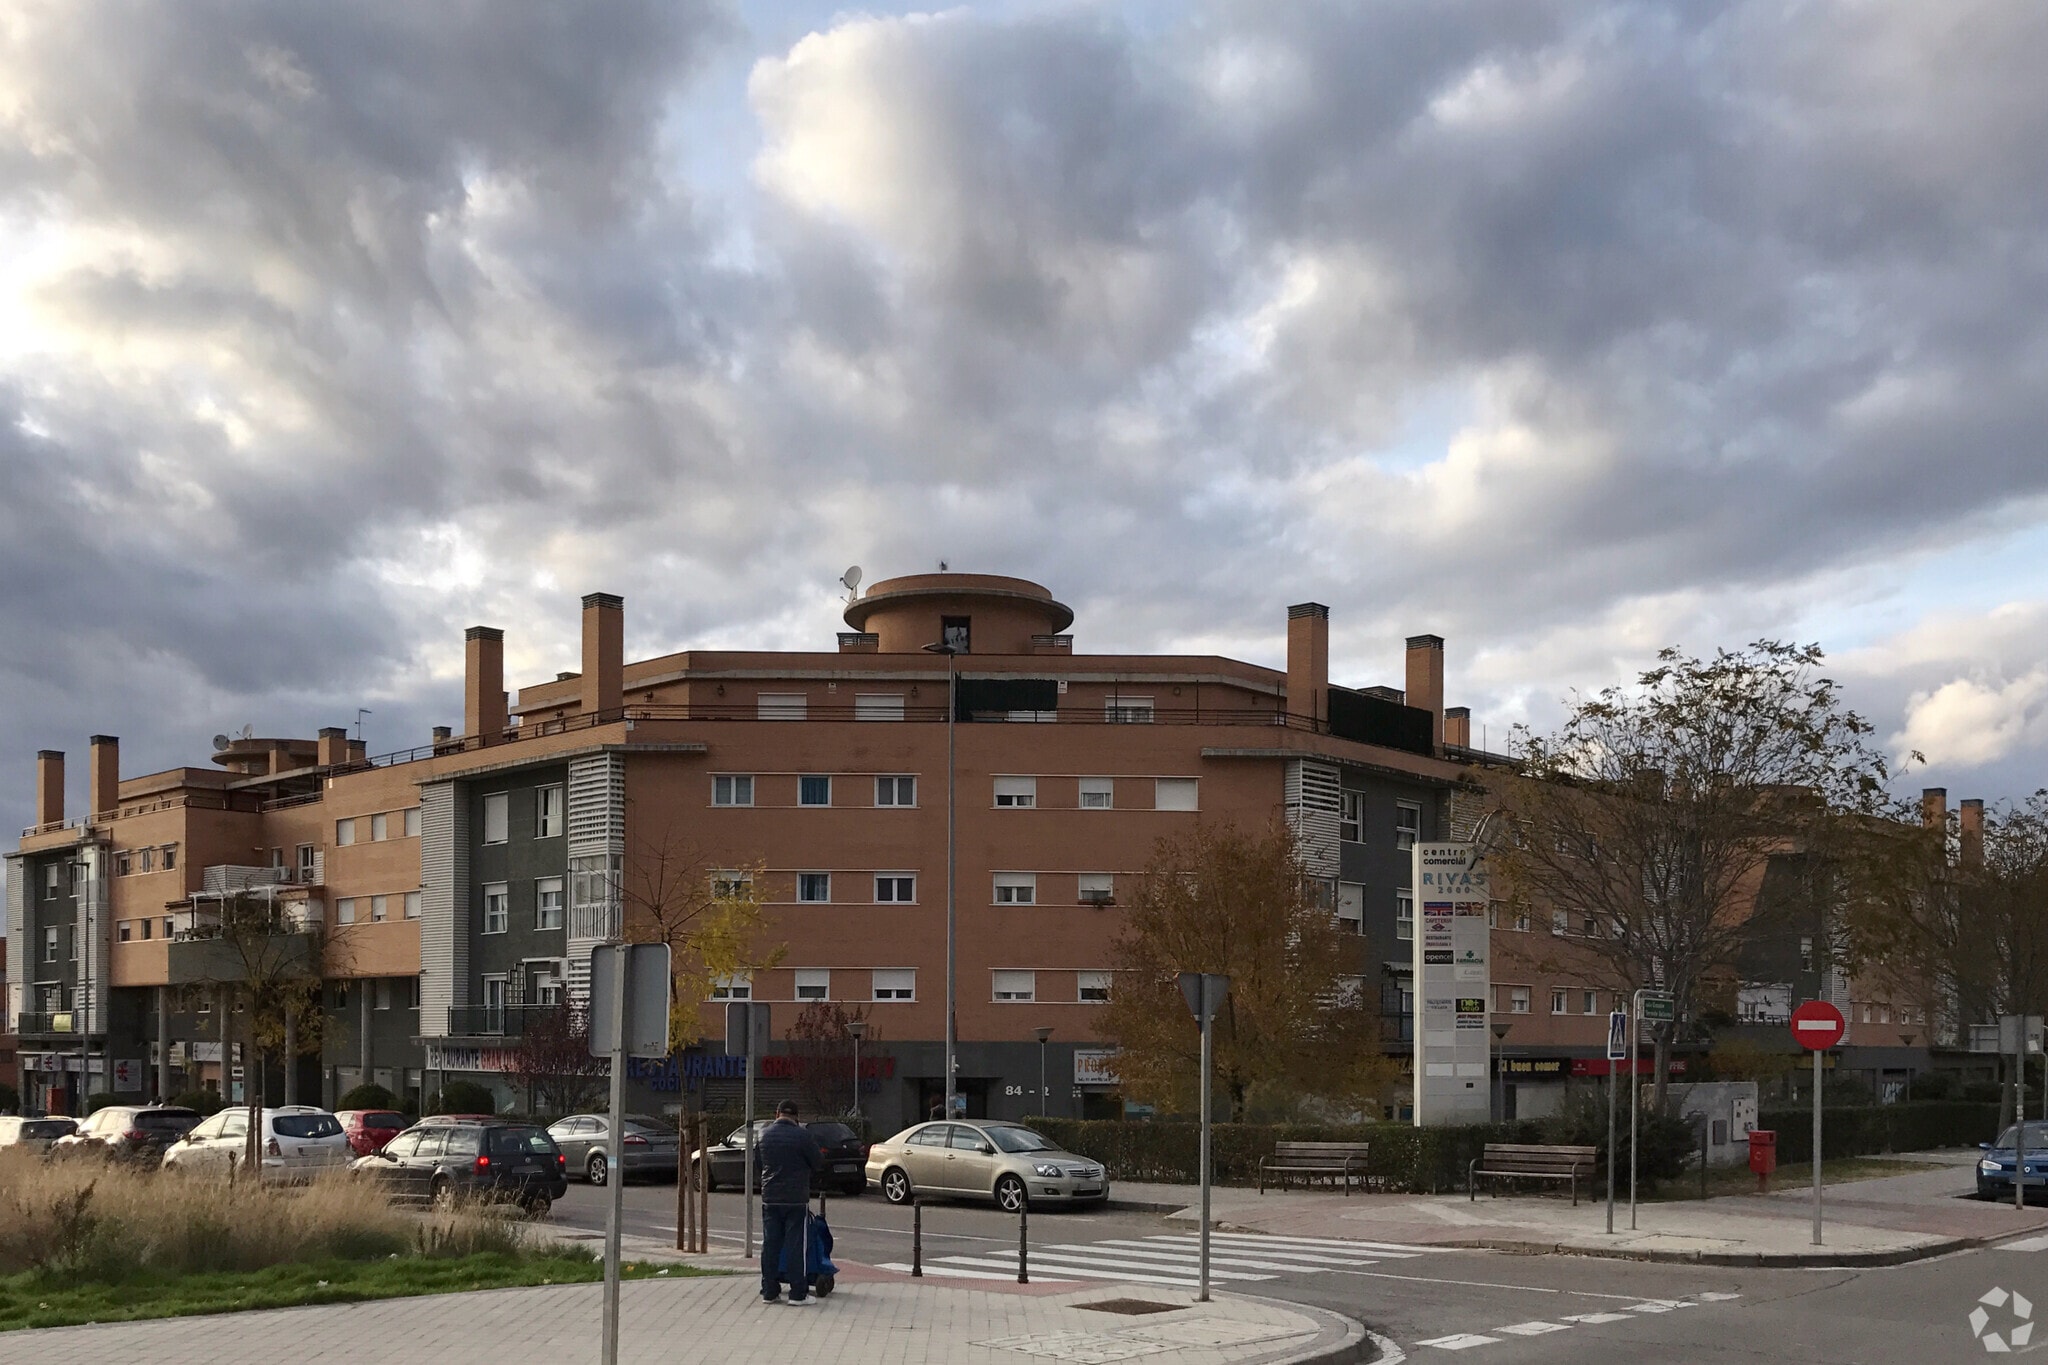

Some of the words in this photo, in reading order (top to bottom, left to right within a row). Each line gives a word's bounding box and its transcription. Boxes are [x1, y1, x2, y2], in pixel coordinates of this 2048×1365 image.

[1423, 848, 1466, 856] centro
[1423, 857, 1466, 865] comercial
[1423, 872, 1485, 885] RIVAS
[1438, 886, 1470, 894] 2000
[1425, 953, 1453, 962] opencel
[429, 1047, 479, 1069] RESTAURANTE
[1510, 1060, 1531, 1072] buen
[1535, 1062, 1560, 1072] comer
[1005, 1085, 1023, 1096] 84
